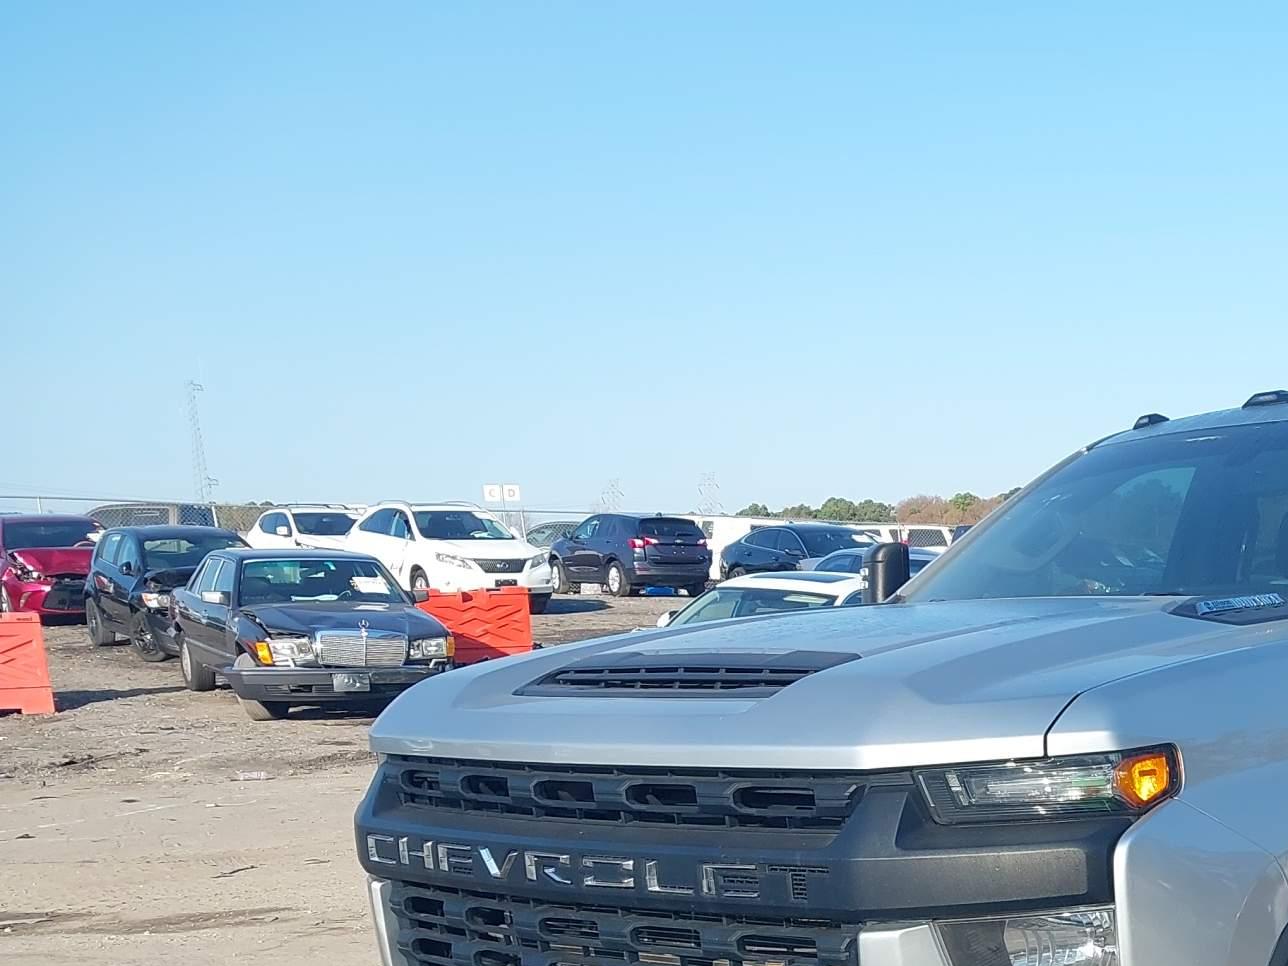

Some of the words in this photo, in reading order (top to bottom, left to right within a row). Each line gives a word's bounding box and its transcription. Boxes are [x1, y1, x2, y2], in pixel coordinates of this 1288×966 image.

[488, 488, 496, 498] C
[508, 488, 516, 498] D
[366, 833, 829, 901] CHEVROLET
